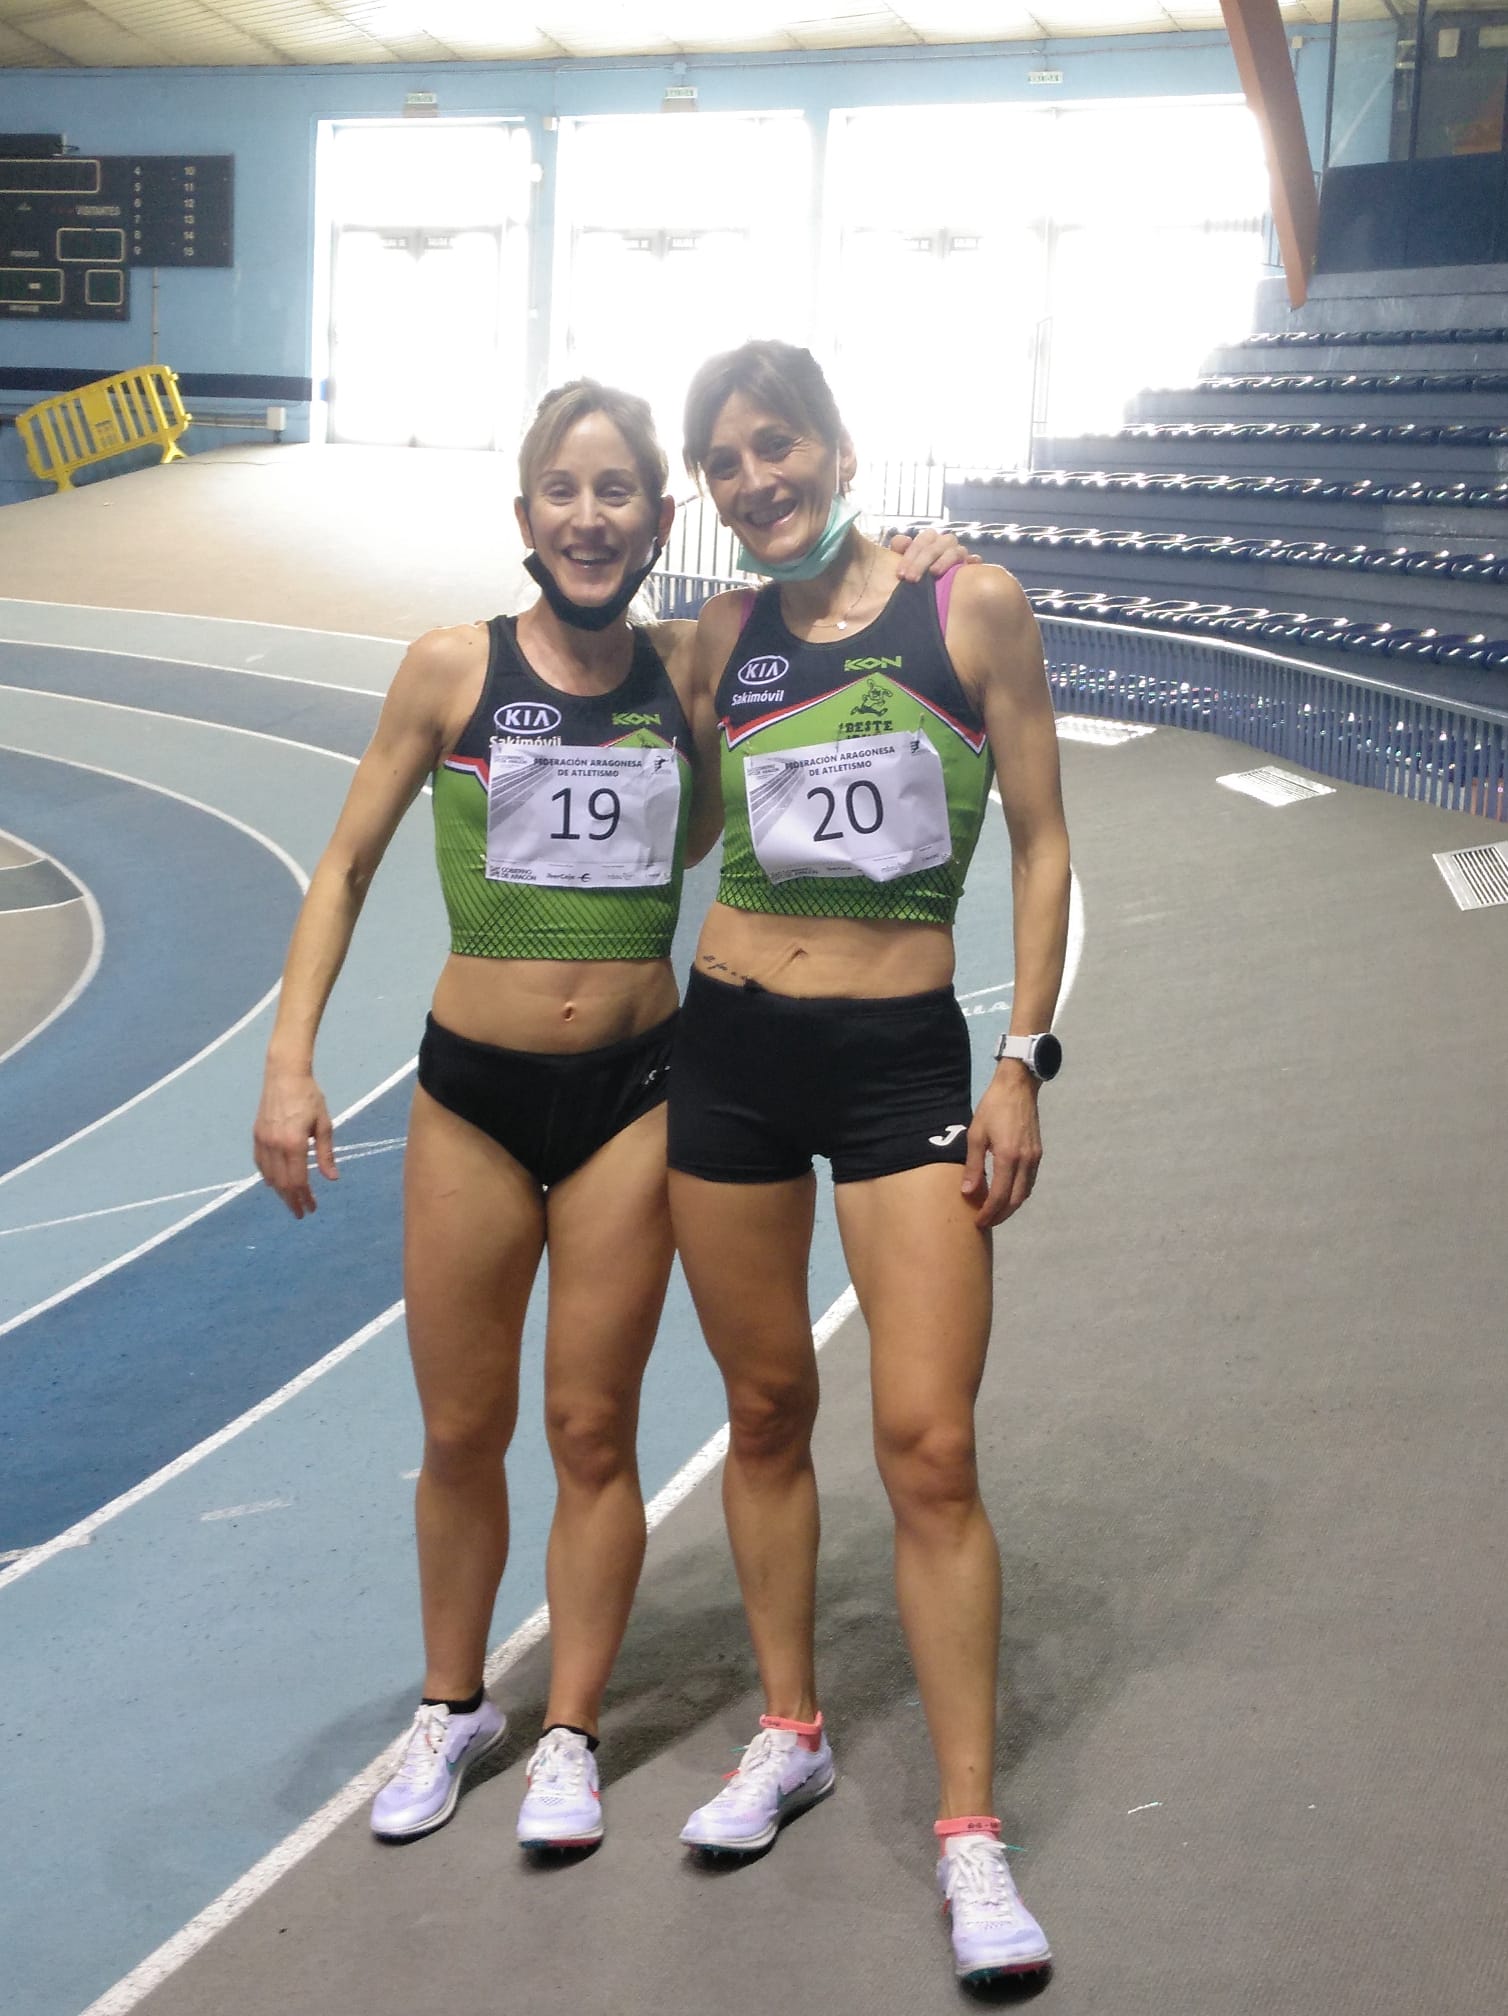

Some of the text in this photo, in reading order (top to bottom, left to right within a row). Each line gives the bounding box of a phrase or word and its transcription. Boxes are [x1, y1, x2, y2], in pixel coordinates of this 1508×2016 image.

[184, 182, 193, 192] 11
[745, 661, 778, 679] KIA
[844, 655, 902, 672] KON
[731, 690, 785, 706] Sakimóvil
[505, 709, 550, 726] KIA
[611, 712, 662, 726] KON
[840, 746, 895, 760] ARAGONESA
[590, 758, 642, 768] ARAGONESA
[809, 760, 872, 777] DE ATLETISMO
[571, 769, 619, 777] ATLETISMO
[550, 787, 621, 841] 19
[807, 779, 884, 842] 20
